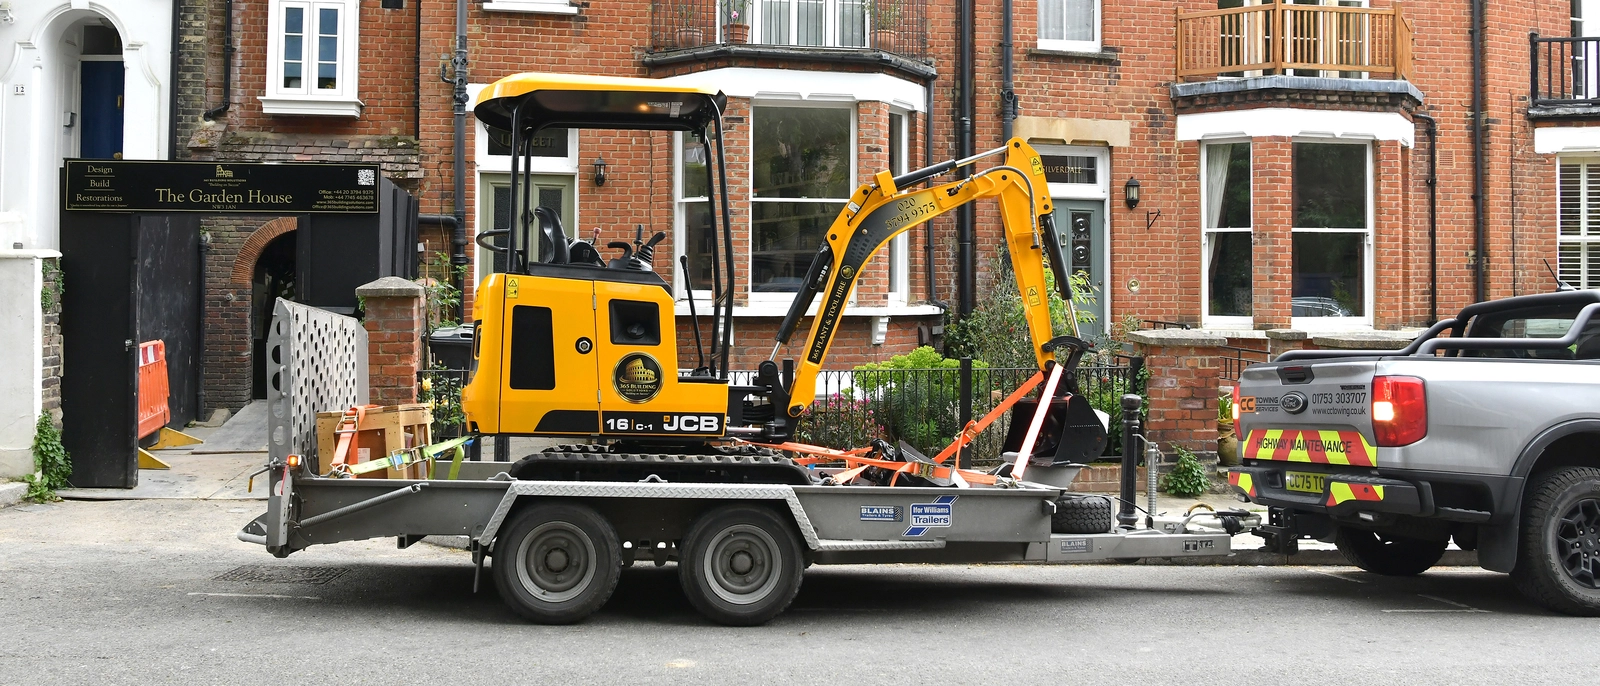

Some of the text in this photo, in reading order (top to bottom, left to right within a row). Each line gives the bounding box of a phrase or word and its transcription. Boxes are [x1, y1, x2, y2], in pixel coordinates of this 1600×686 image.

[87, 165, 112, 174] Design
[155, 188, 293, 204] The Garden House
[897, 198, 916, 212] 020
[885, 202, 935, 230] 3794 9375
[816, 326, 828, 349] PLANT
[828, 298, 839, 317] TOOL
[836, 281, 846, 298] HIRE
[1240, 398, 1254, 411] CC
[1284, 398, 1297, 407] Ford
[1312, 393, 1366, 404] 01753 303707
[1312, 407, 1366, 416] www.cctowing.co.uk
[606, 419, 628, 430] 16
[663, 416, 718, 431] JCB
[1256, 438, 1352, 453] HIGHWAY MAINTENANCE
[1290, 474, 1311, 489] CC75
